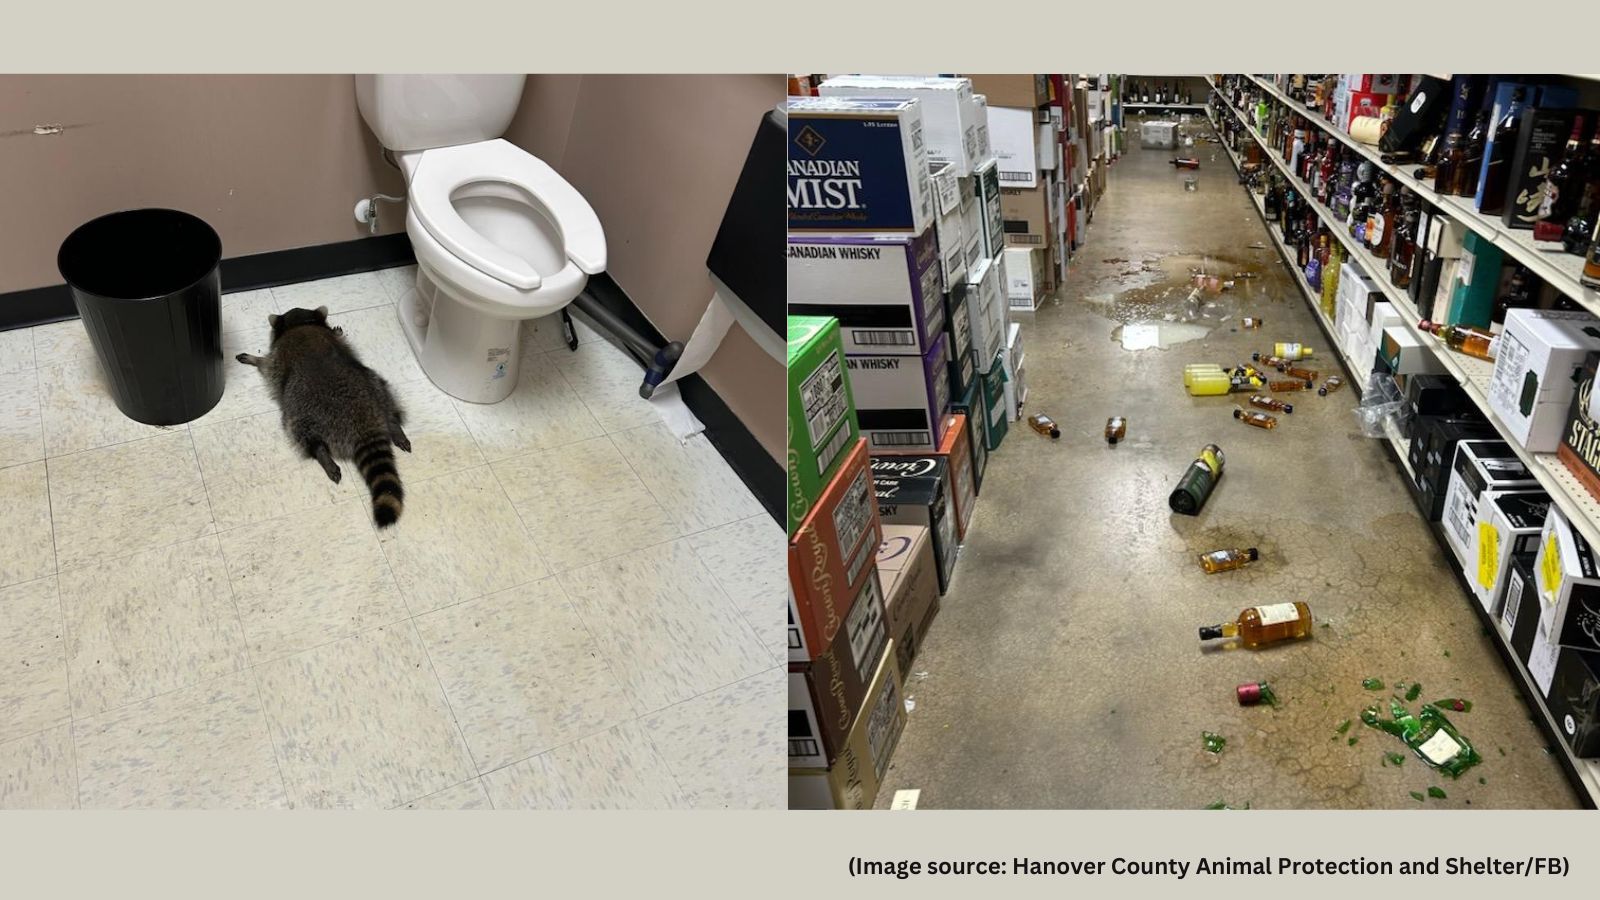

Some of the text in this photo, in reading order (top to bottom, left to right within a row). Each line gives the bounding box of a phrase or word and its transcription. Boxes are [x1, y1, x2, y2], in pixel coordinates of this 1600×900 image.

[788, 159, 860, 176] ANADIAN
[788, 178, 863, 209] MIST
[838, 247, 880, 260] WHISKY
[860, 358, 900, 369] WHISKY
[879, 504, 897, 516] SKY
